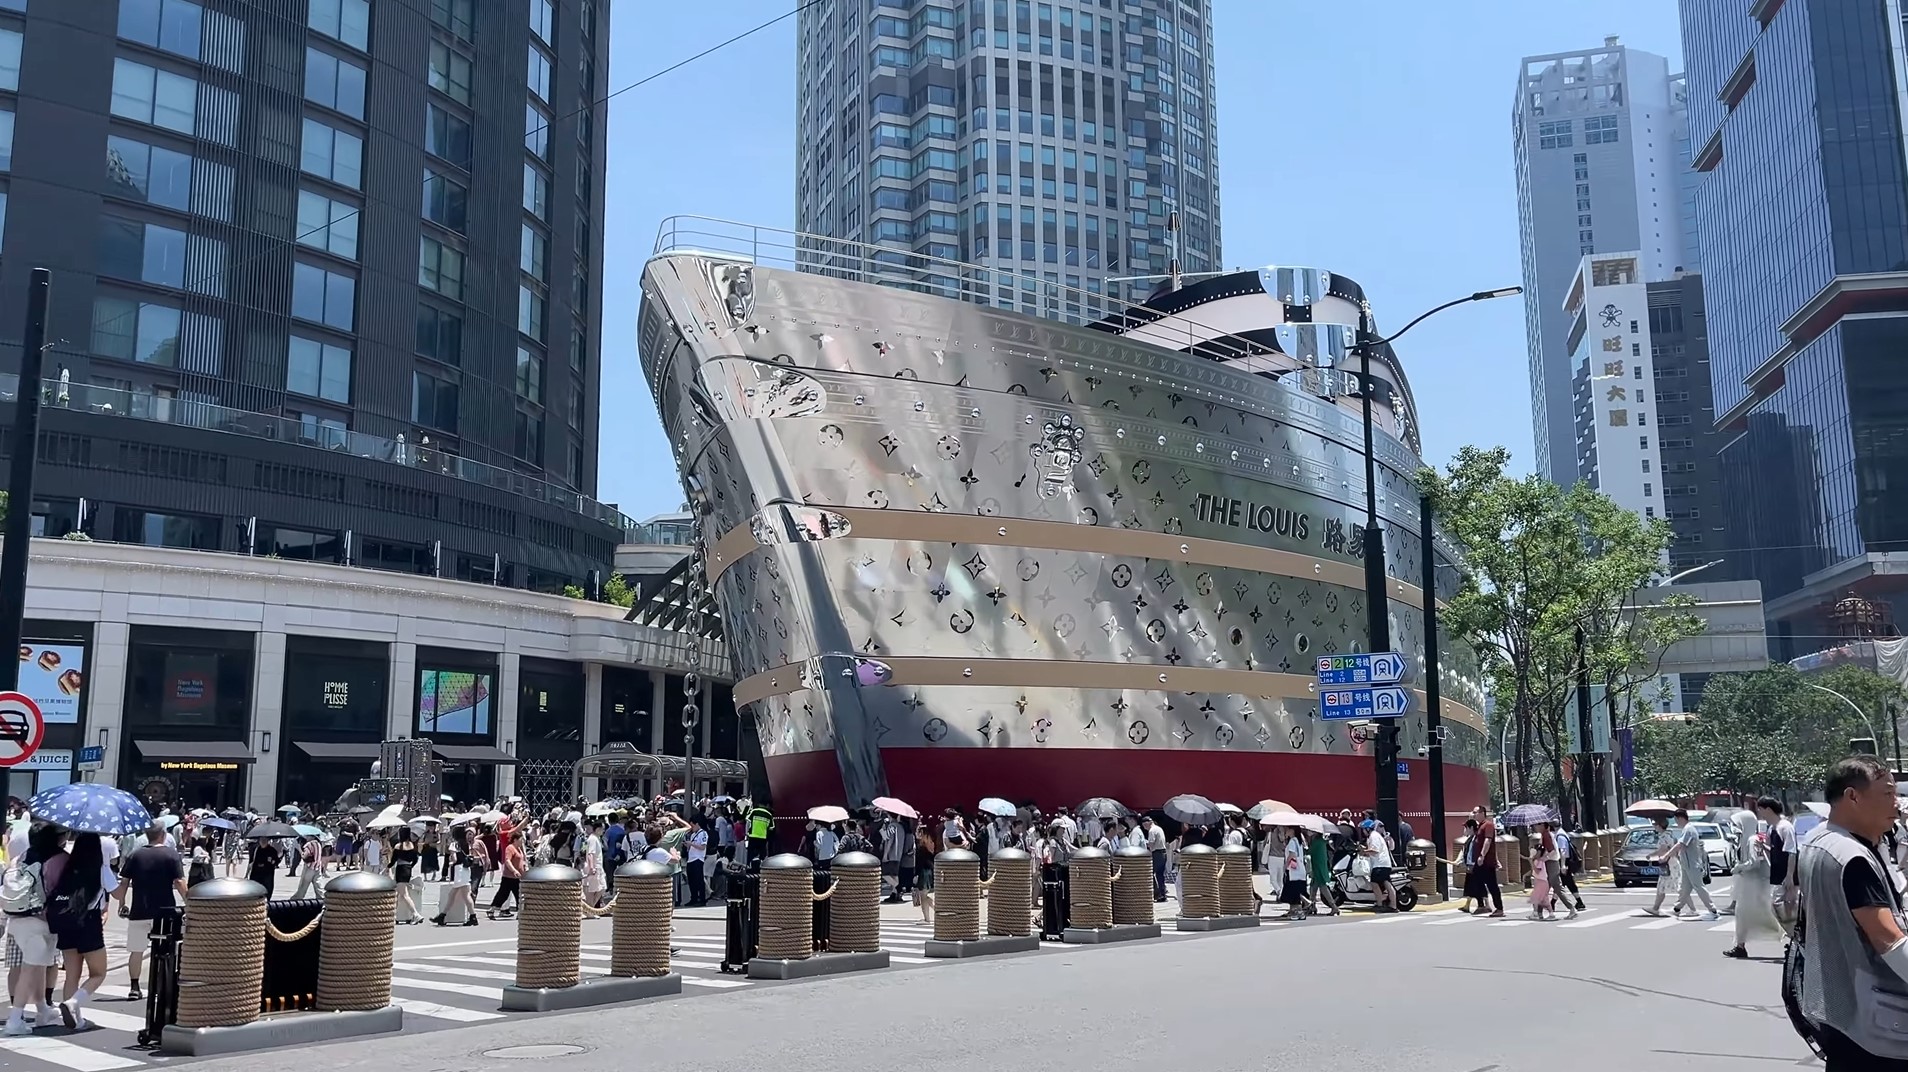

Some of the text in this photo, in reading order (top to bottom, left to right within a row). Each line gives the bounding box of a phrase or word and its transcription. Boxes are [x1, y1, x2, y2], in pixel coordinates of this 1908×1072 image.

[1196, 493, 1241, 527] THE
[1245, 502, 1309, 540] LOUIS
[324, 681, 349, 693] HOMME
[30, 755, 38, 763] &
[38, 755, 70, 764] JUICE
[160, 762, 168, 770] by
